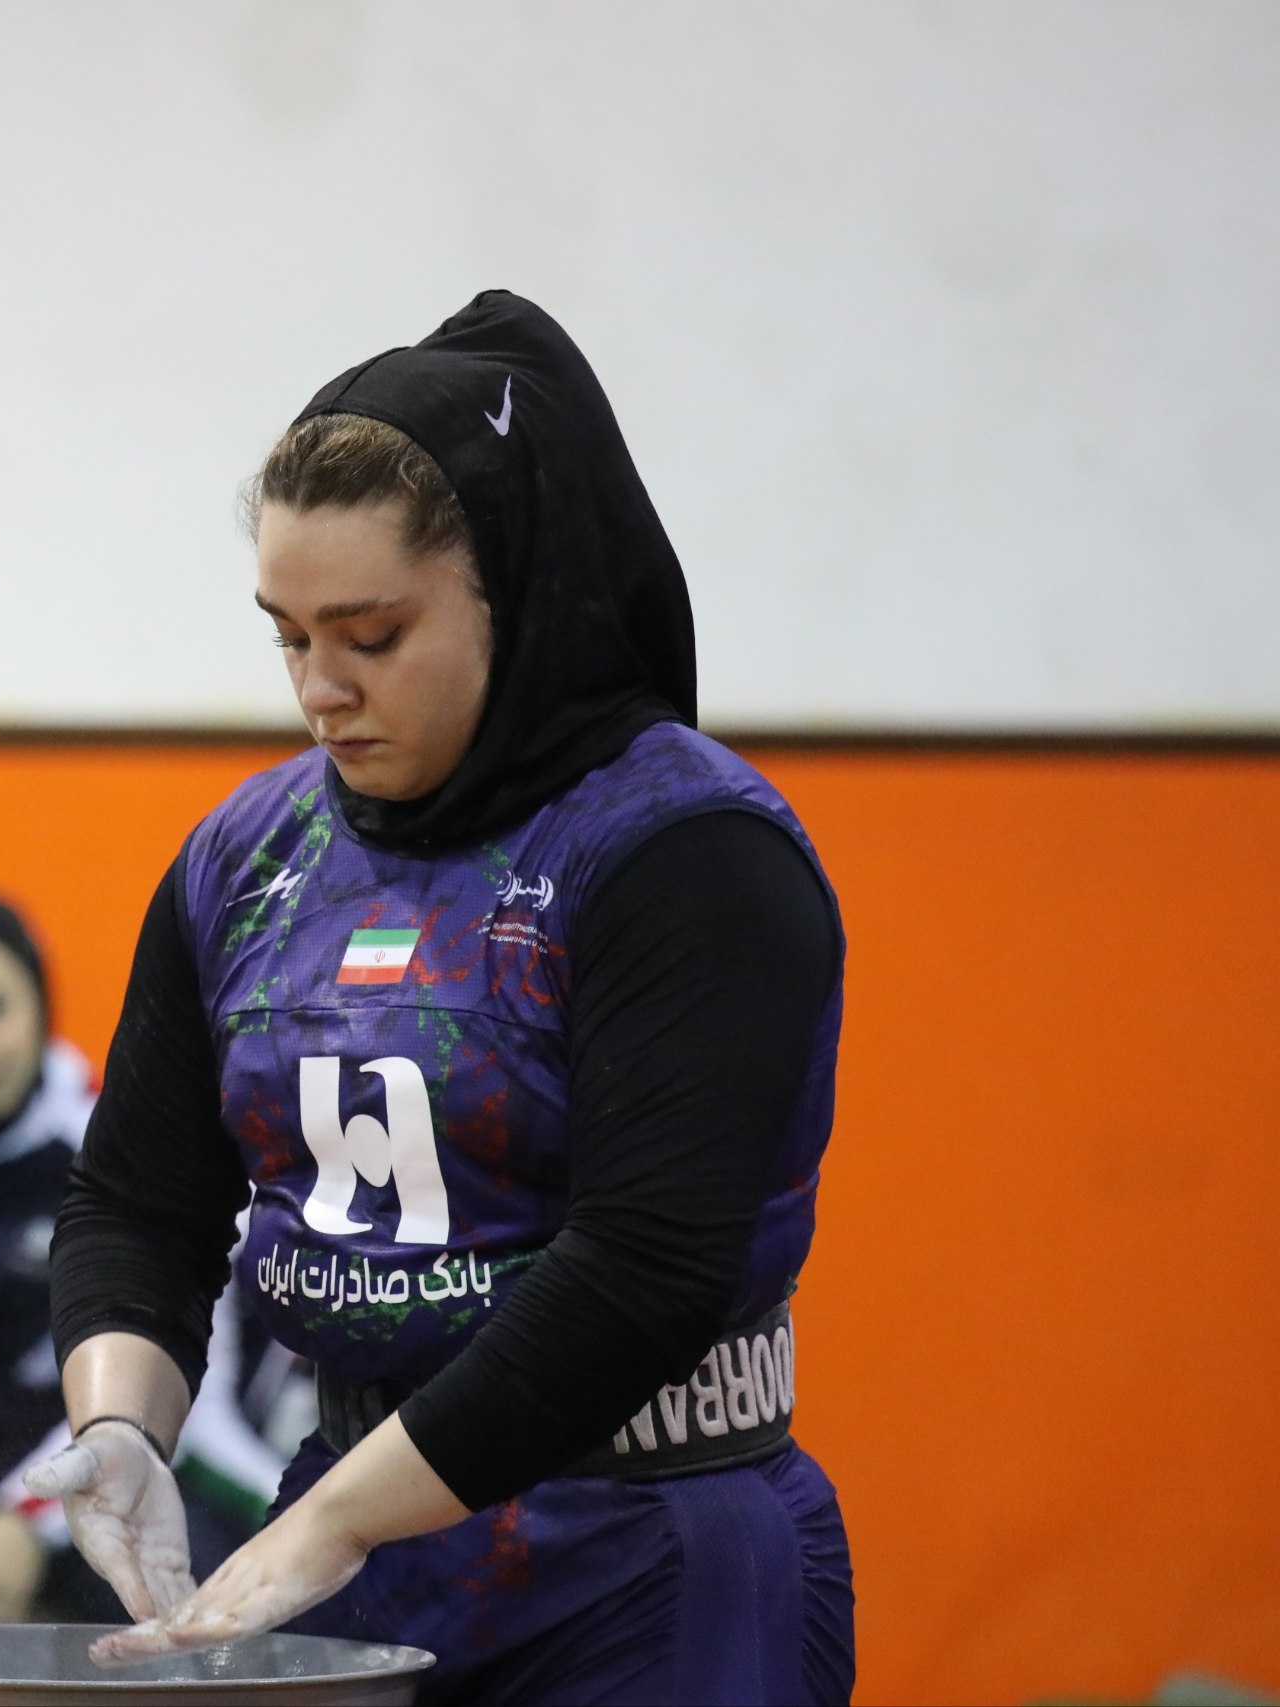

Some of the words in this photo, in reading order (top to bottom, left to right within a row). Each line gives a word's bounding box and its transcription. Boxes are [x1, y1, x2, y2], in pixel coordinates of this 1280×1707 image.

[257, 1243, 299, 1306] ایران
[301, 1254, 410, 1312] صادرات
[418, 1250, 492, 1307] بانک
